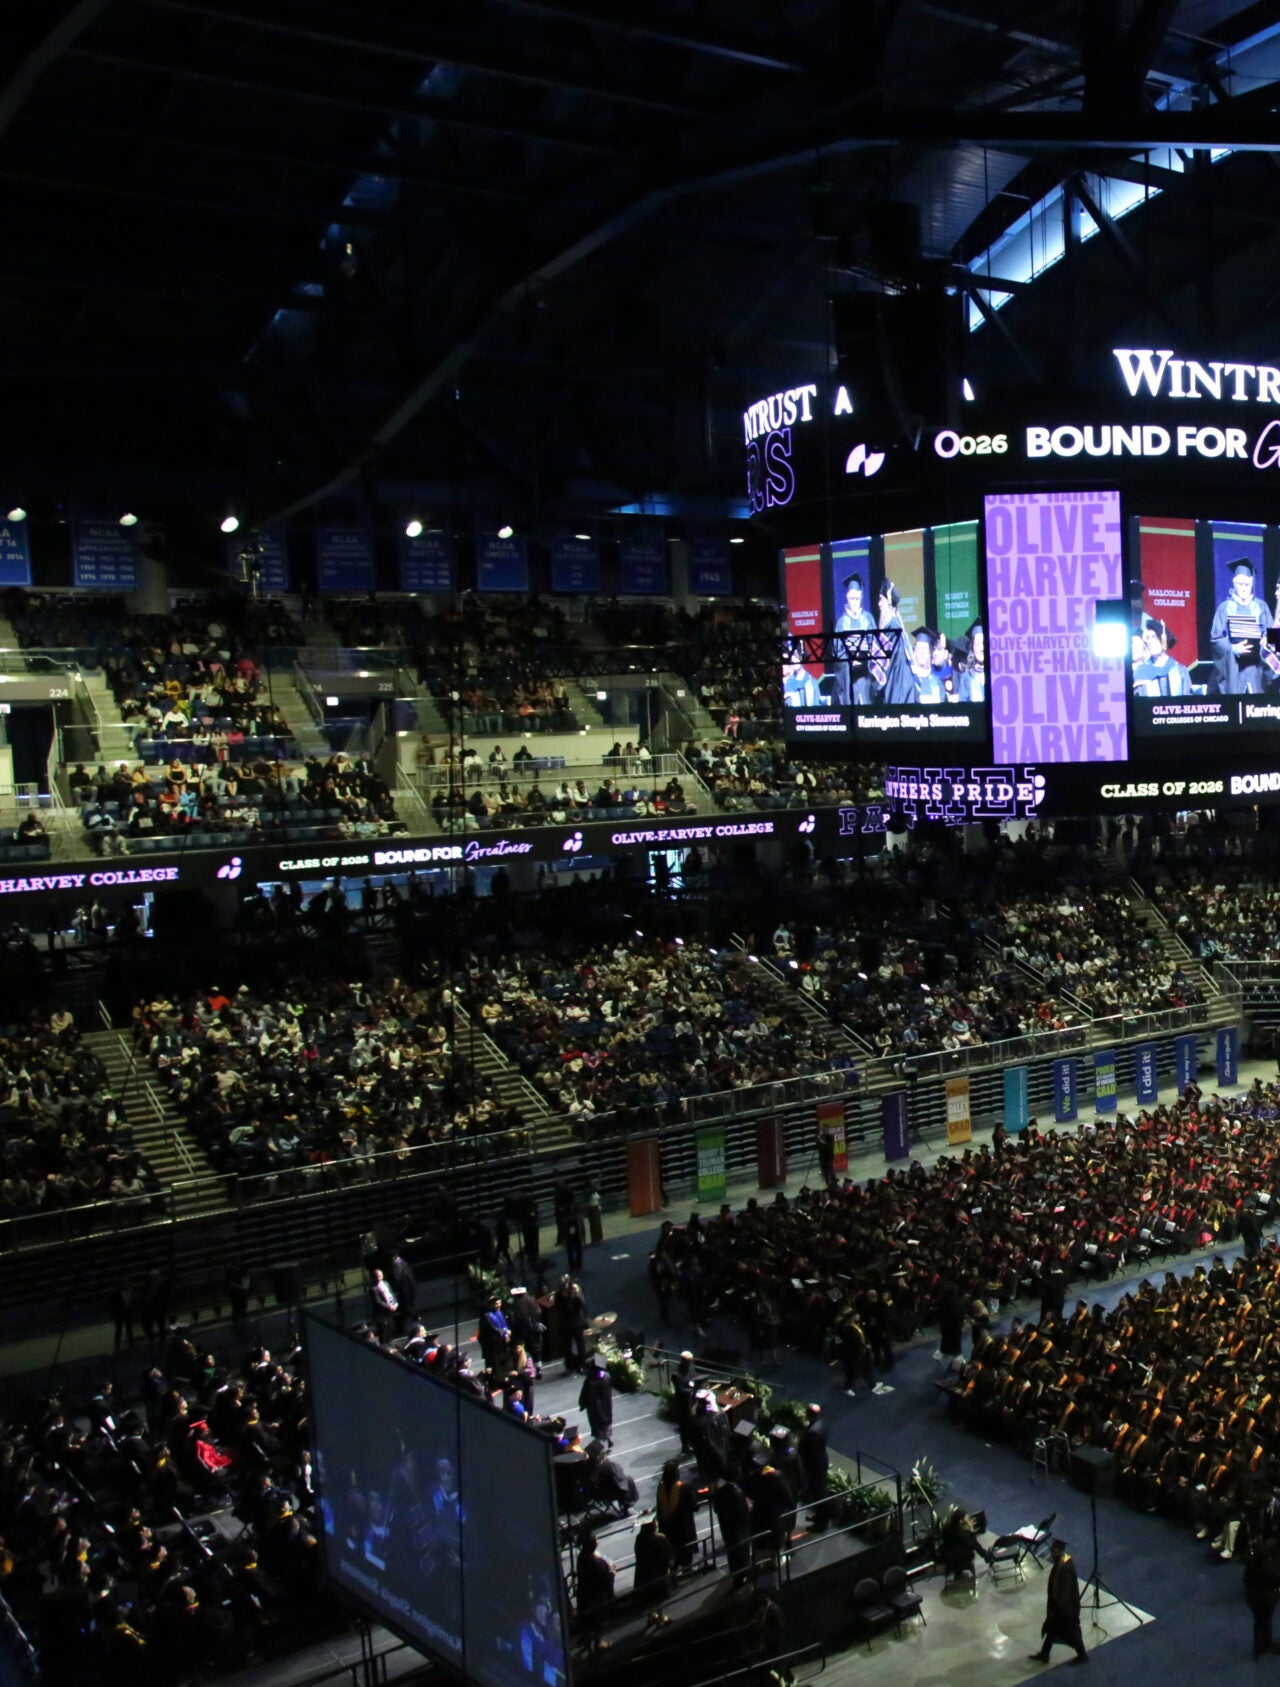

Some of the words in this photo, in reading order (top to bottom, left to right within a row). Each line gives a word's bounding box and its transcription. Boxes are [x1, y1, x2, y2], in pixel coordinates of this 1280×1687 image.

[1027, 426, 1169, 457] BOUND
[1177, 428, 1248, 458] FOR
[986, 504, 1122, 556] OLIVE-
[987, 553, 1122, 598] HARVEY
[1148, 589, 1182, 598] MALCOLM
[1184, 590, 1191, 598] X
[1153, 598, 1186, 607] COLLEGE
[990, 635, 1072, 651] OLIVE-HARVEY
[50, 688, 69, 698] 224
[992, 673, 1126, 725] OLIVE-
[1152, 704, 1222, 715] OLIVE-HARVEY
[1152, 716, 1165, 724] CITY
[1166, 716, 1194, 724] COLLEGES
[1203, 714, 1229, 723] CHICAGO
[993, 723, 1127, 764] HARVEY
[952, 783, 1034, 801] PRIDE
[1100, 783, 1160, 798] CLASS
[1162, 782, 1186, 796] OF
[1188, 780, 1224, 794] 2026
[1230, 772, 1280, 795] BOUND
[611, 827, 713, 845] OLIVE-HARVEY
[715, 822, 774, 836] COLLEGE
[280, 858, 321, 870] CLASS
[322, 857, 339, 867] OF
[341, 855, 369, 866] 2026
[374, 847, 432, 865] BOUND
[432, 846, 462, 860] FOR
[0, 874, 86, 893] HARVEY
[90, 867, 179, 885] COLLEGE
[1061, 1076, 1070, 1094] did
[1142, 1066, 1152, 1087] did
[1062, 1095, 1071, 1113] We
